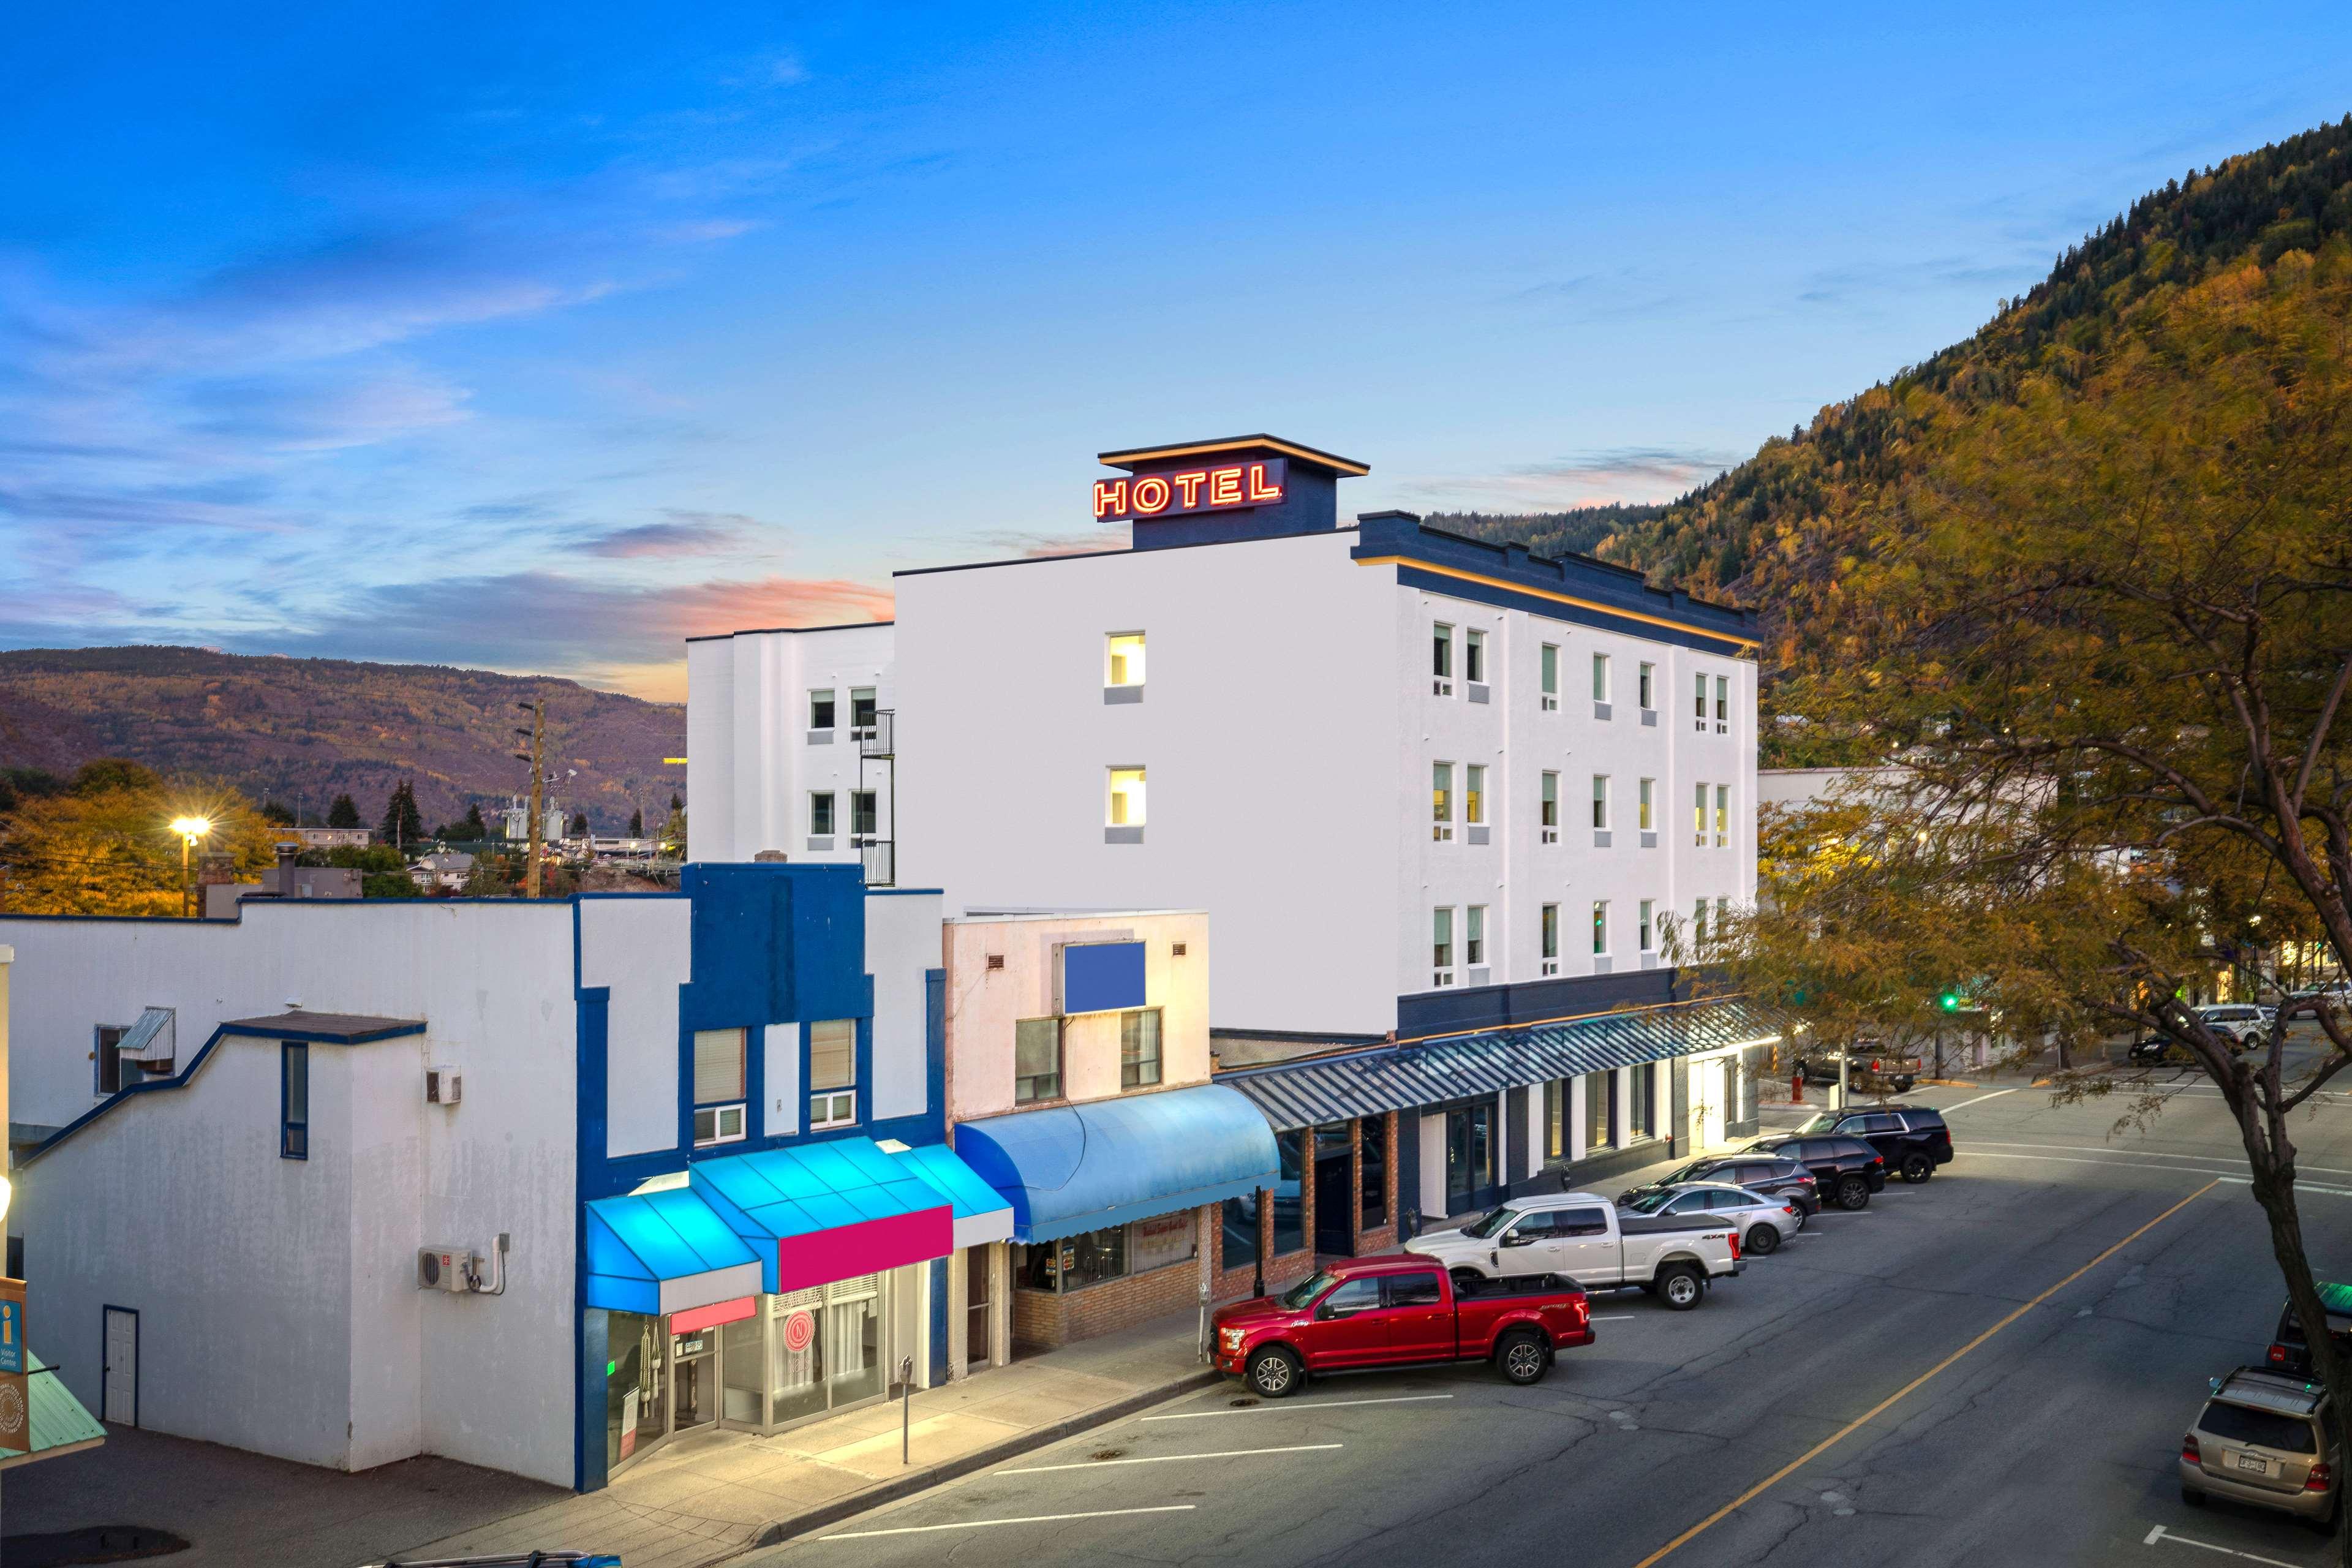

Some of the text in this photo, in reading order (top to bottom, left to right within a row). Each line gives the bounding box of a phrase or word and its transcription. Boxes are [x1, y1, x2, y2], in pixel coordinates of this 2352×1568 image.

[1093, 464, 1282, 518] HOTEL
[1, 1348, 16, 1358] Visitor
[0, 1357, 17, 1366] Centre
[788, 1355, 811, 1373] Nails
